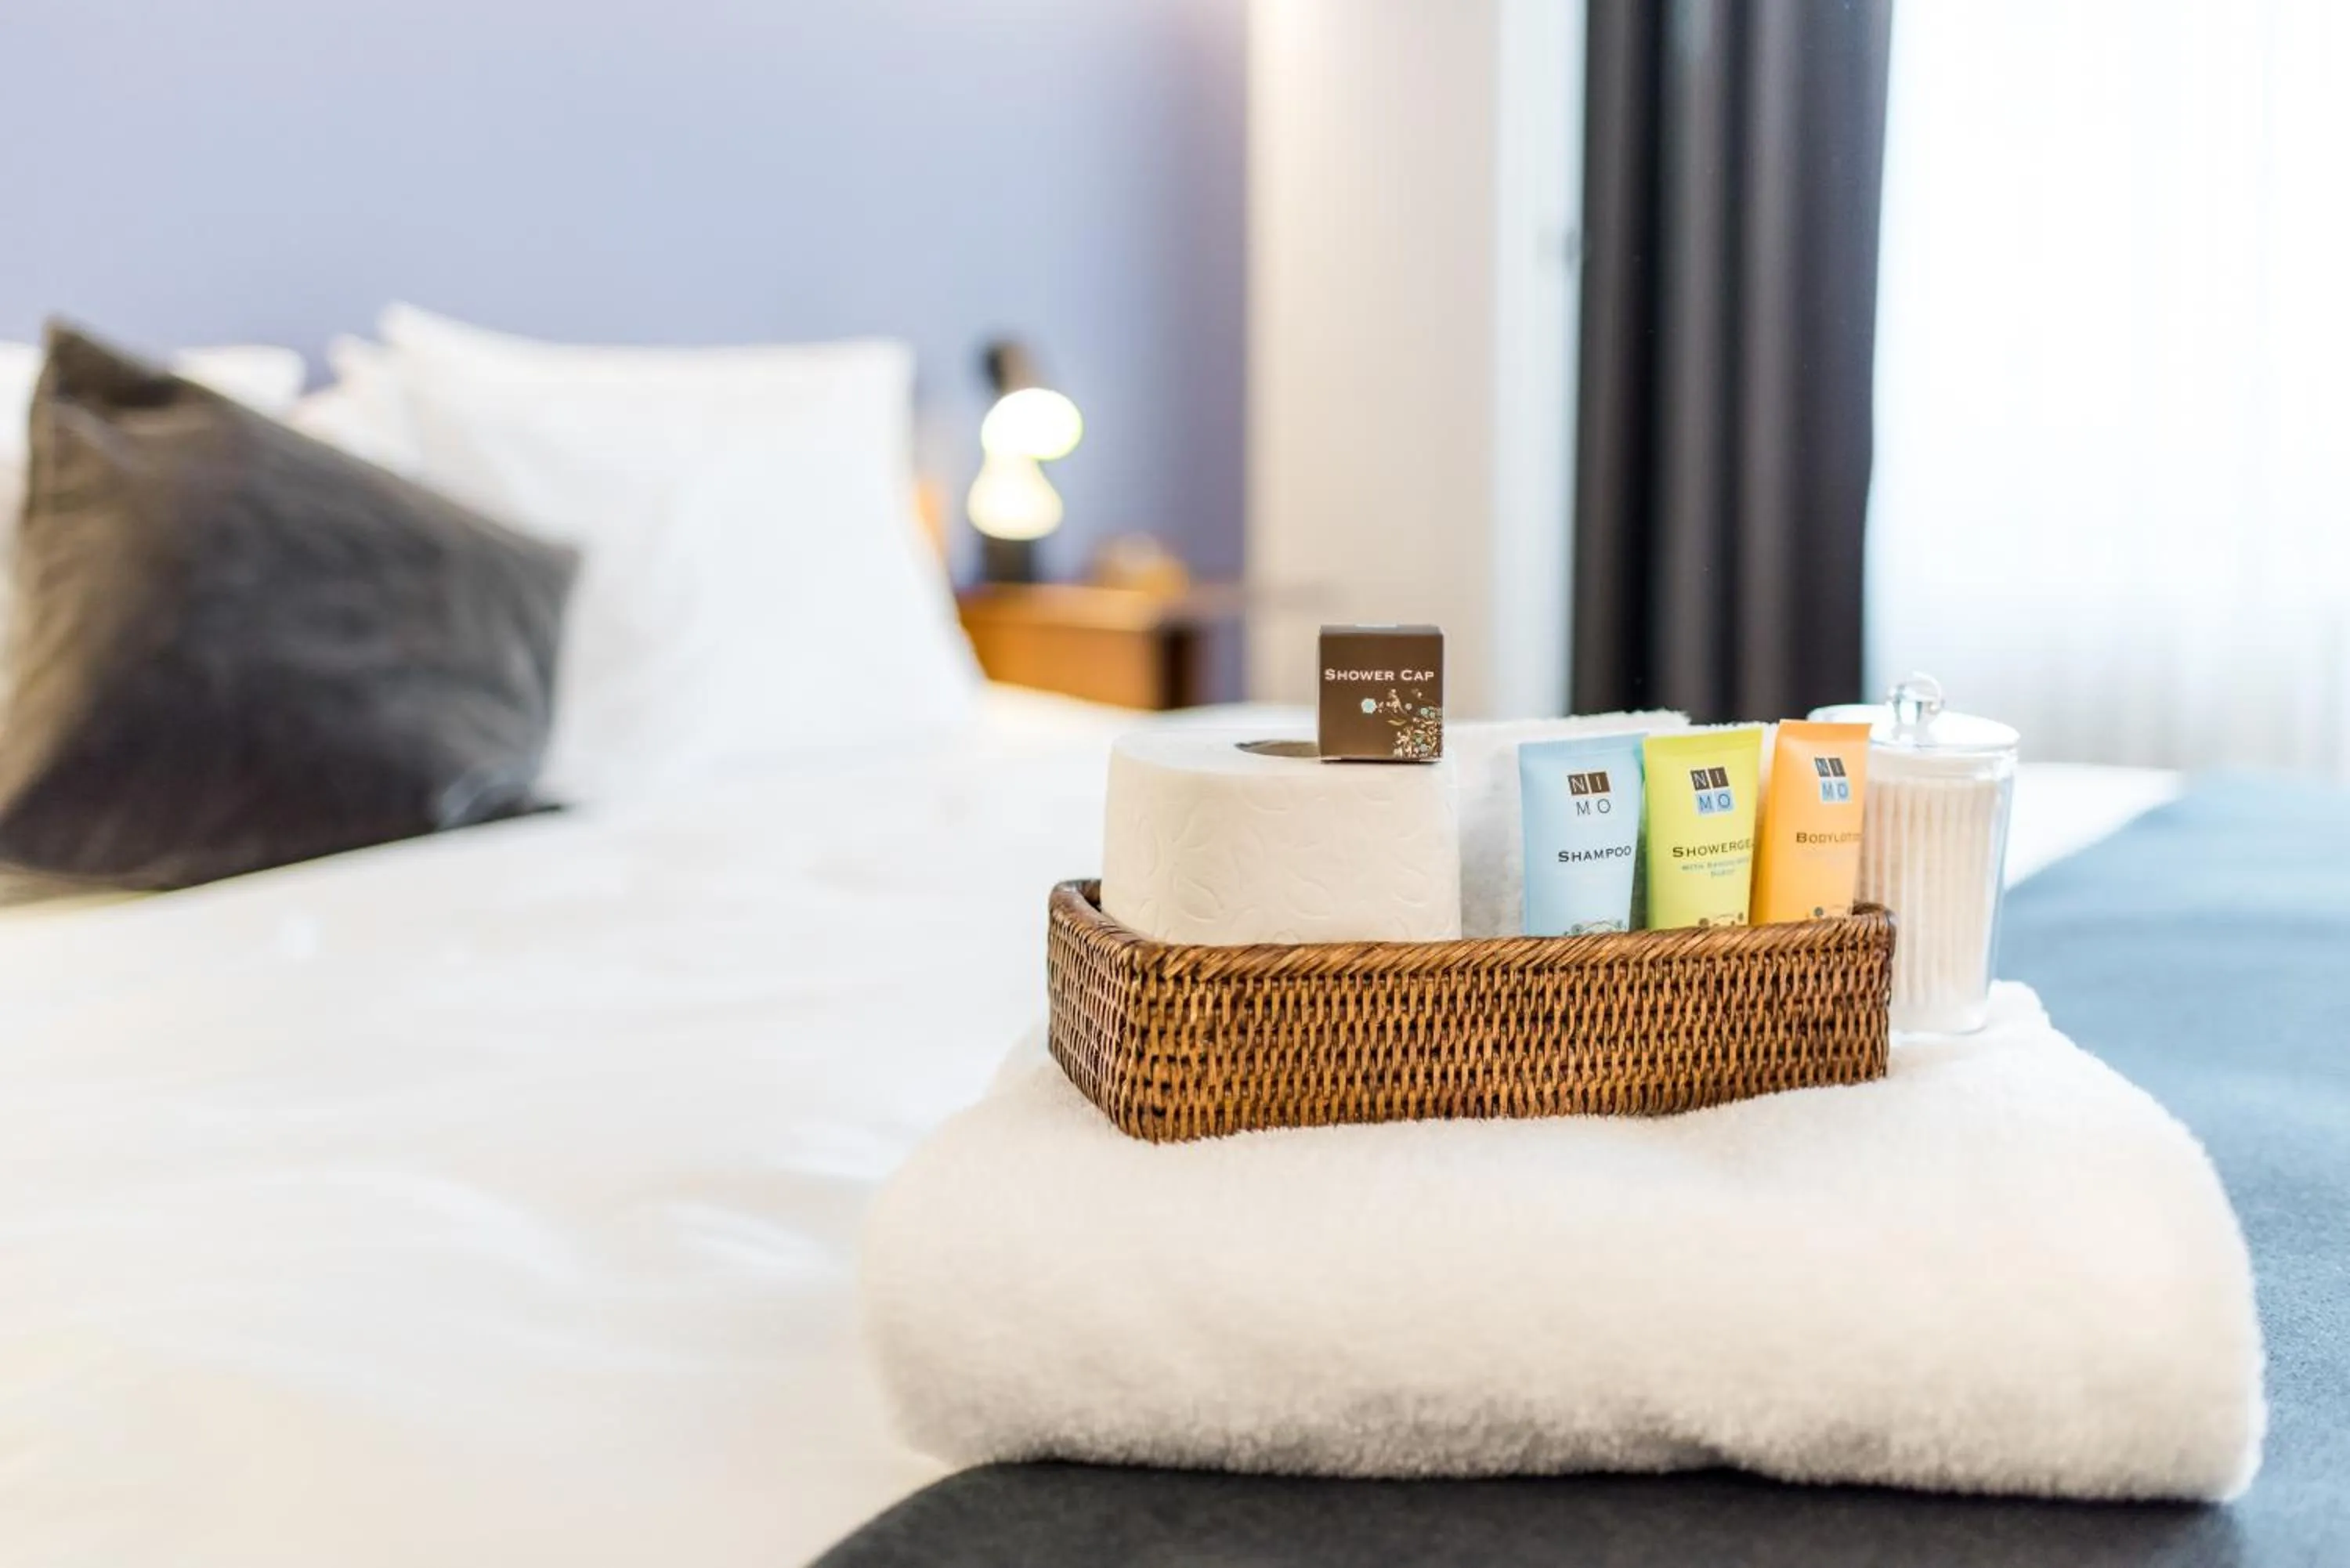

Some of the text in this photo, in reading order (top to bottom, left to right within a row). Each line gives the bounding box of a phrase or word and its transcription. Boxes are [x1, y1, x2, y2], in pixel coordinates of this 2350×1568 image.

[1325, 669, 1434, 681] SHOWER CAP
[1570, 775, 1603, 793] NI
[1576, 798, 1611, 816] MO
[1558, 846, 1632, 862] SHAMPOO
[1672, 839, 1755, 858] SHOWERGE
